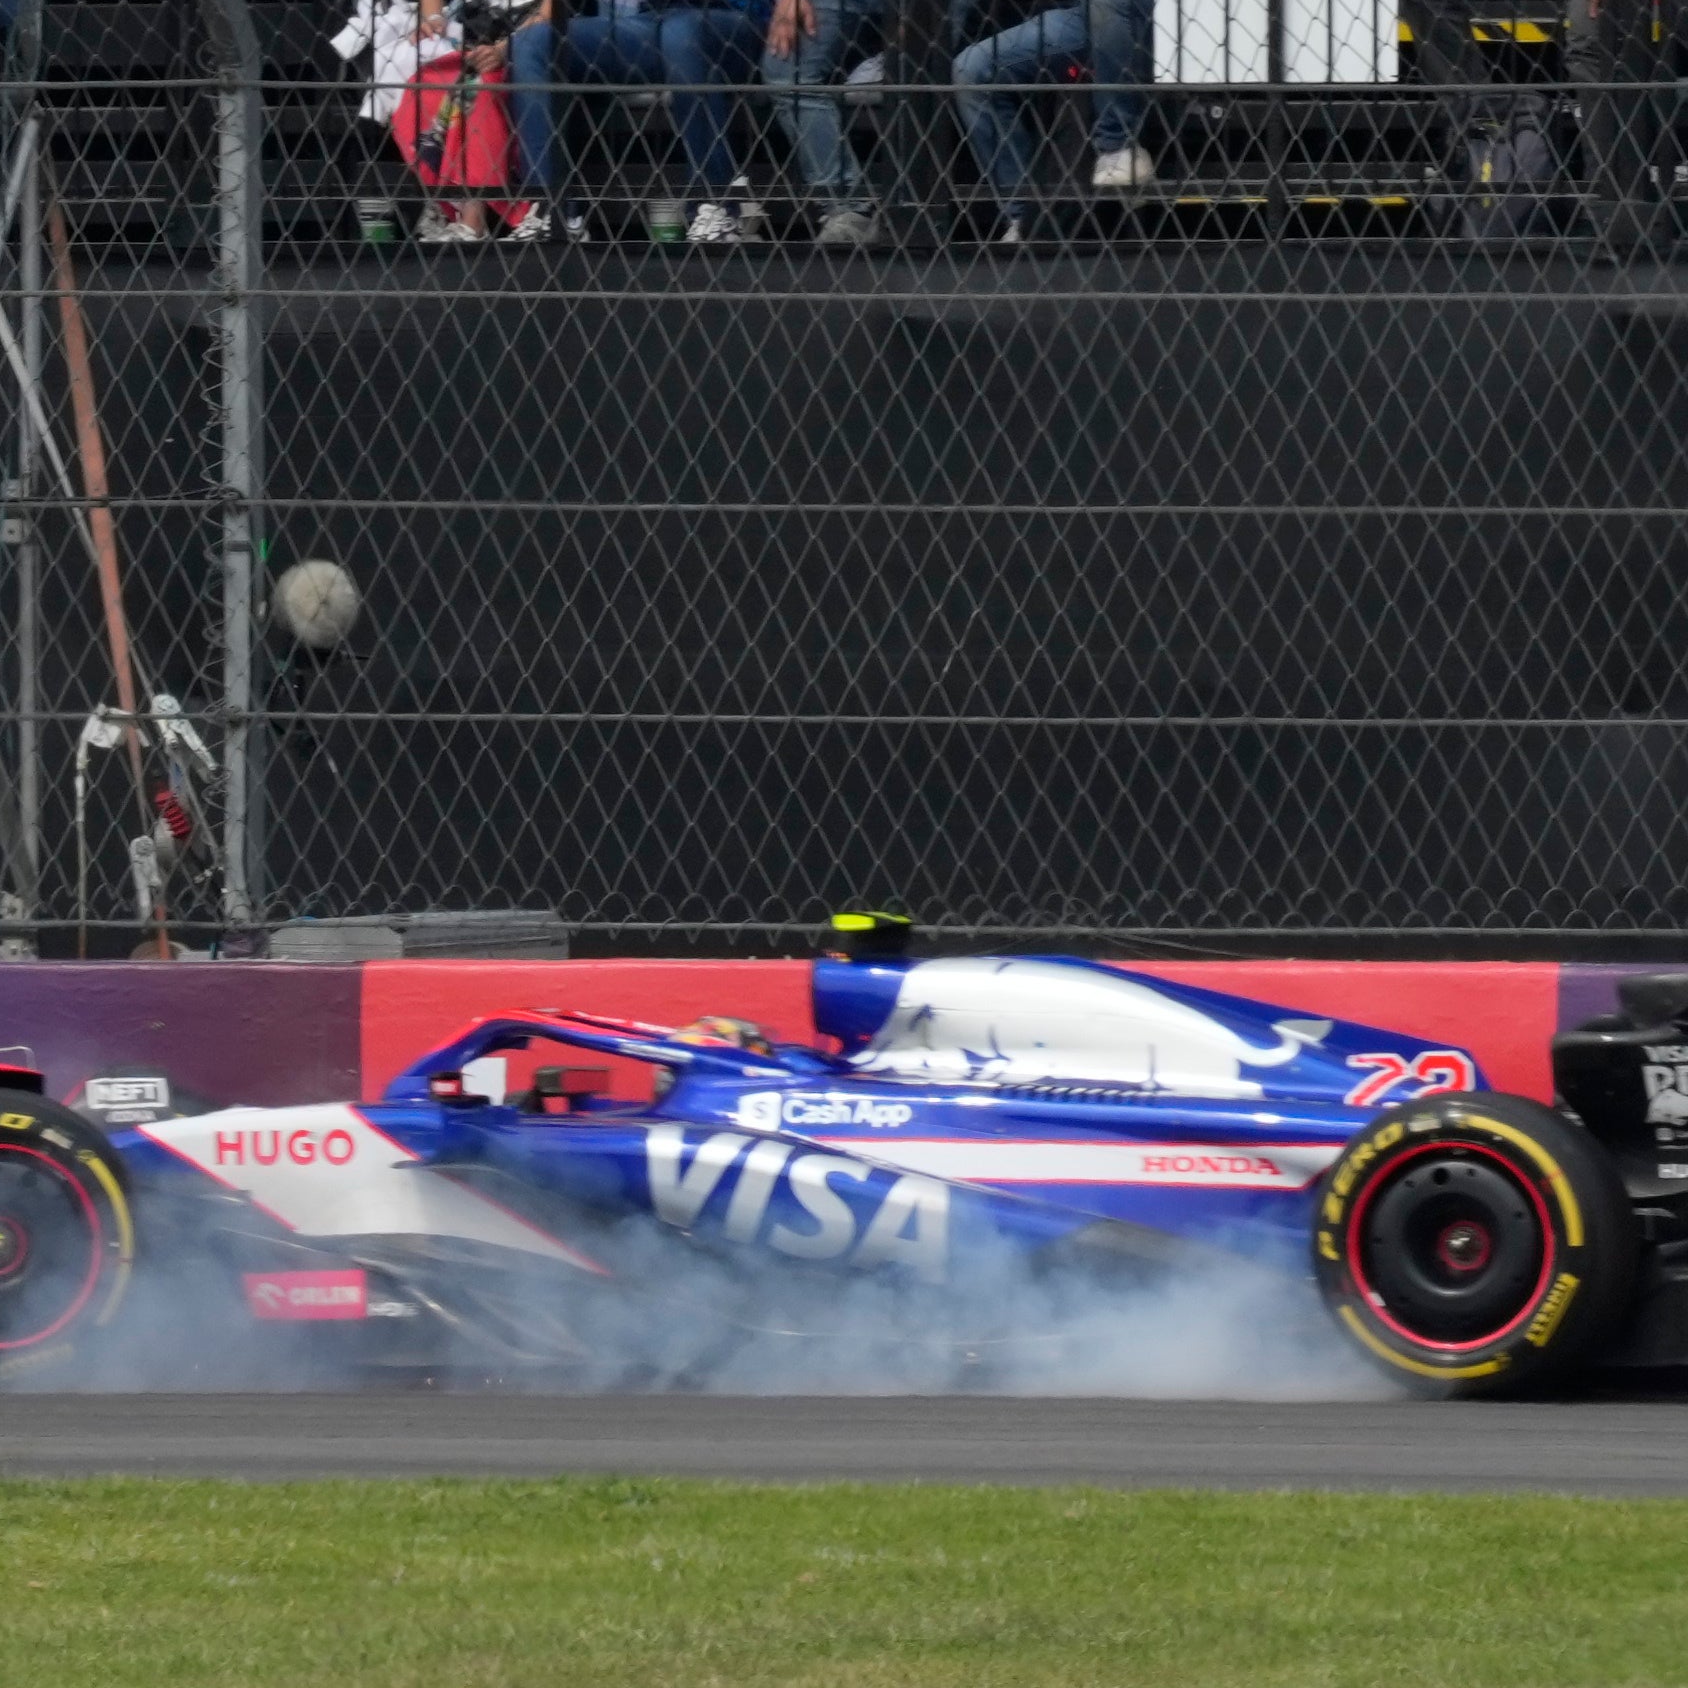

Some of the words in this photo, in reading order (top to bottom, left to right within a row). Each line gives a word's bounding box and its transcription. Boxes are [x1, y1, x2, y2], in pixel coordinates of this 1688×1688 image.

[782, 1099, 853, 1124] Cash
[853, 1099, 913, 1128] App
[215, 1128, 355, 1166] HUGO
[1141, 1155, 1285, 1177] HONDA
[1323, 1122, 1406, 1225] ZERO
[646, 1124, 952, 1285] VISA
